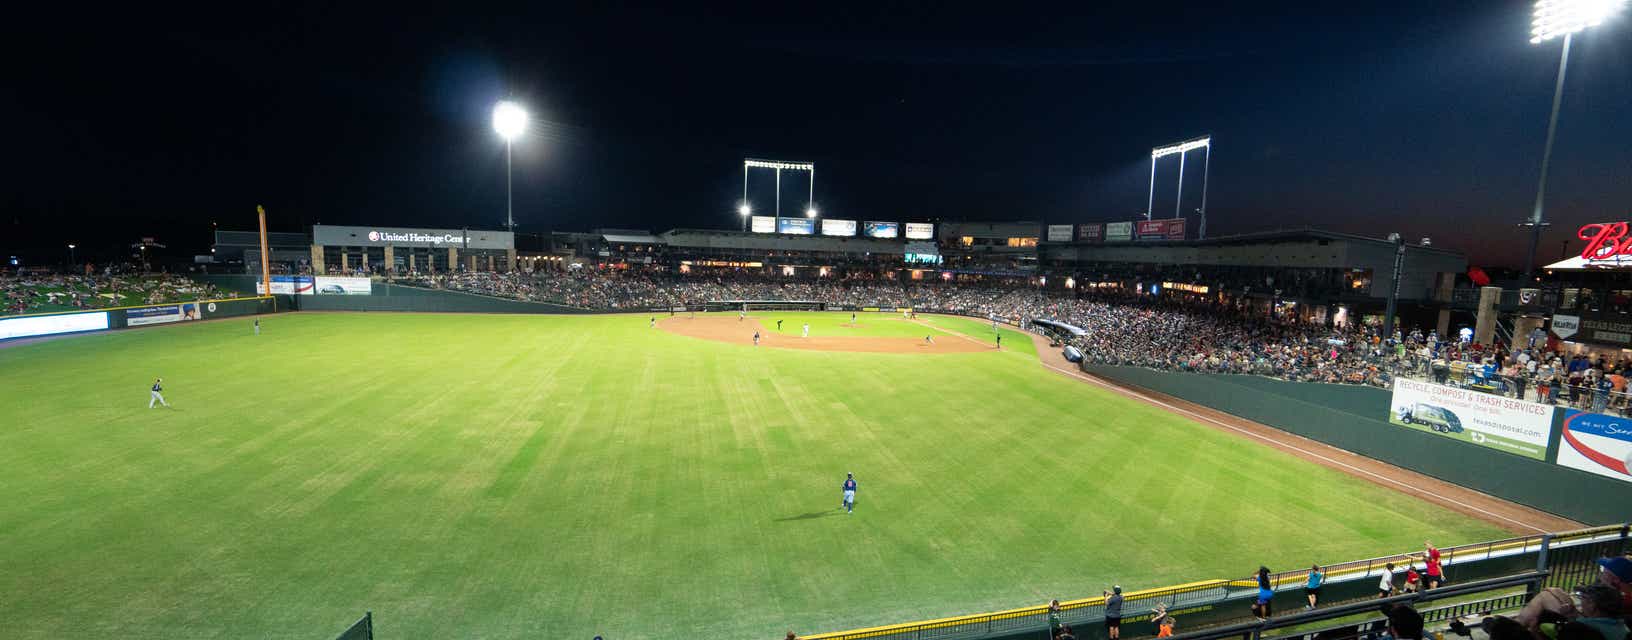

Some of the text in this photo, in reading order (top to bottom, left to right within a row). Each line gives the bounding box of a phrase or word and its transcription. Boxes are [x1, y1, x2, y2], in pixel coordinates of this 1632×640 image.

[380, 232, 471, 244] United Heritage Centr
[1432, 387, 1466, 400] COMPOST
[1467, 392, 1474, 402] &
[1476, 395, 1502, 406] TRASH
[1503, 399, 1546, 415] SERVICES
[1473, 417, 1543, 438] texasdisposal.com
